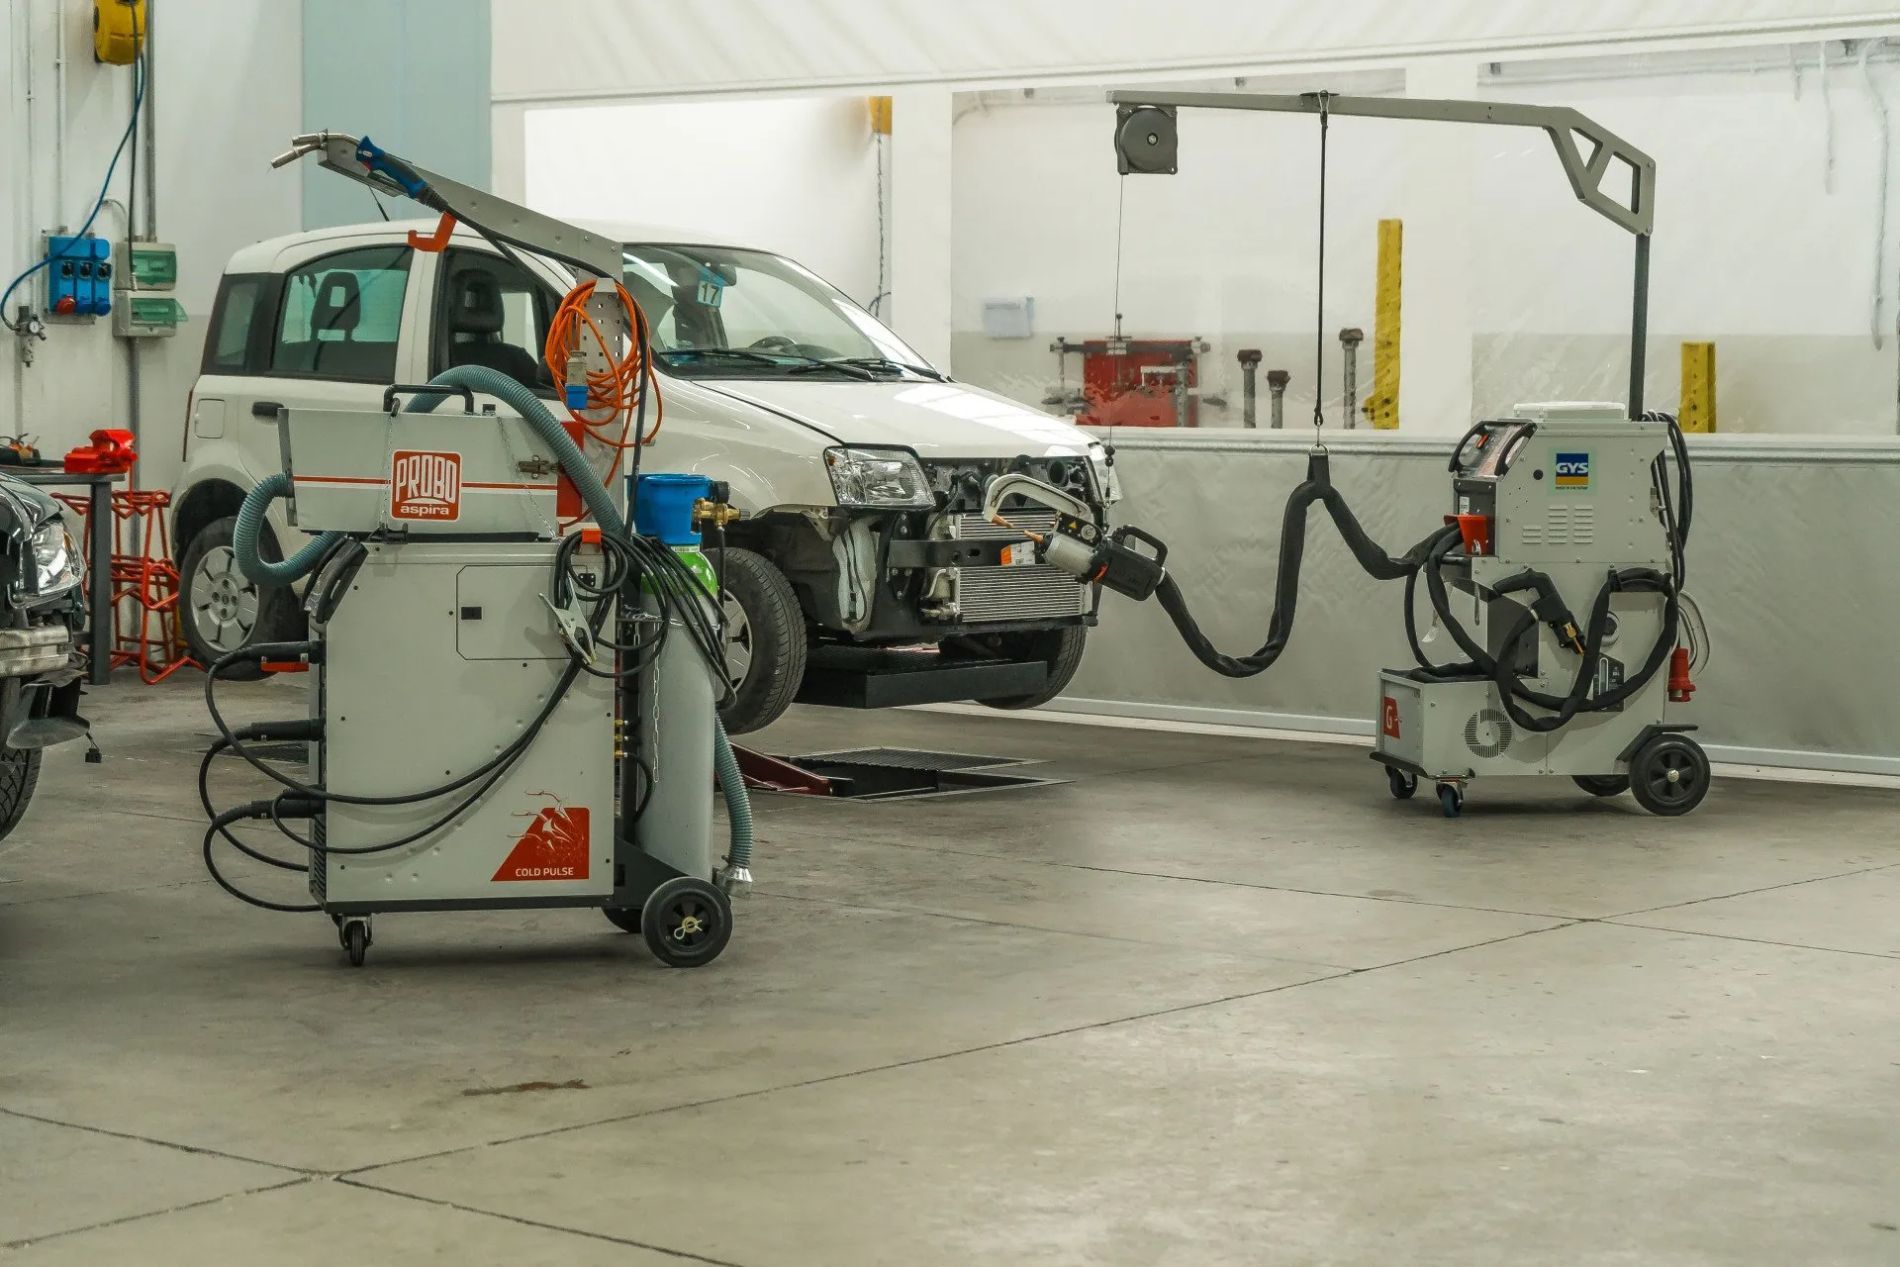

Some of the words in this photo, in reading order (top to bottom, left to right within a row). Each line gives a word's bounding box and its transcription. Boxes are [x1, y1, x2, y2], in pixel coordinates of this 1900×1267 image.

[702, 283, 720, 304] 17
[1556, 462, 1589, 474] GYS
[396, 454, 457, 504] PROBO
[400, 504, 450, 517] aspira
[515, 868, 541, 877] COLD
[543, 867, 574, 876] PULSE
